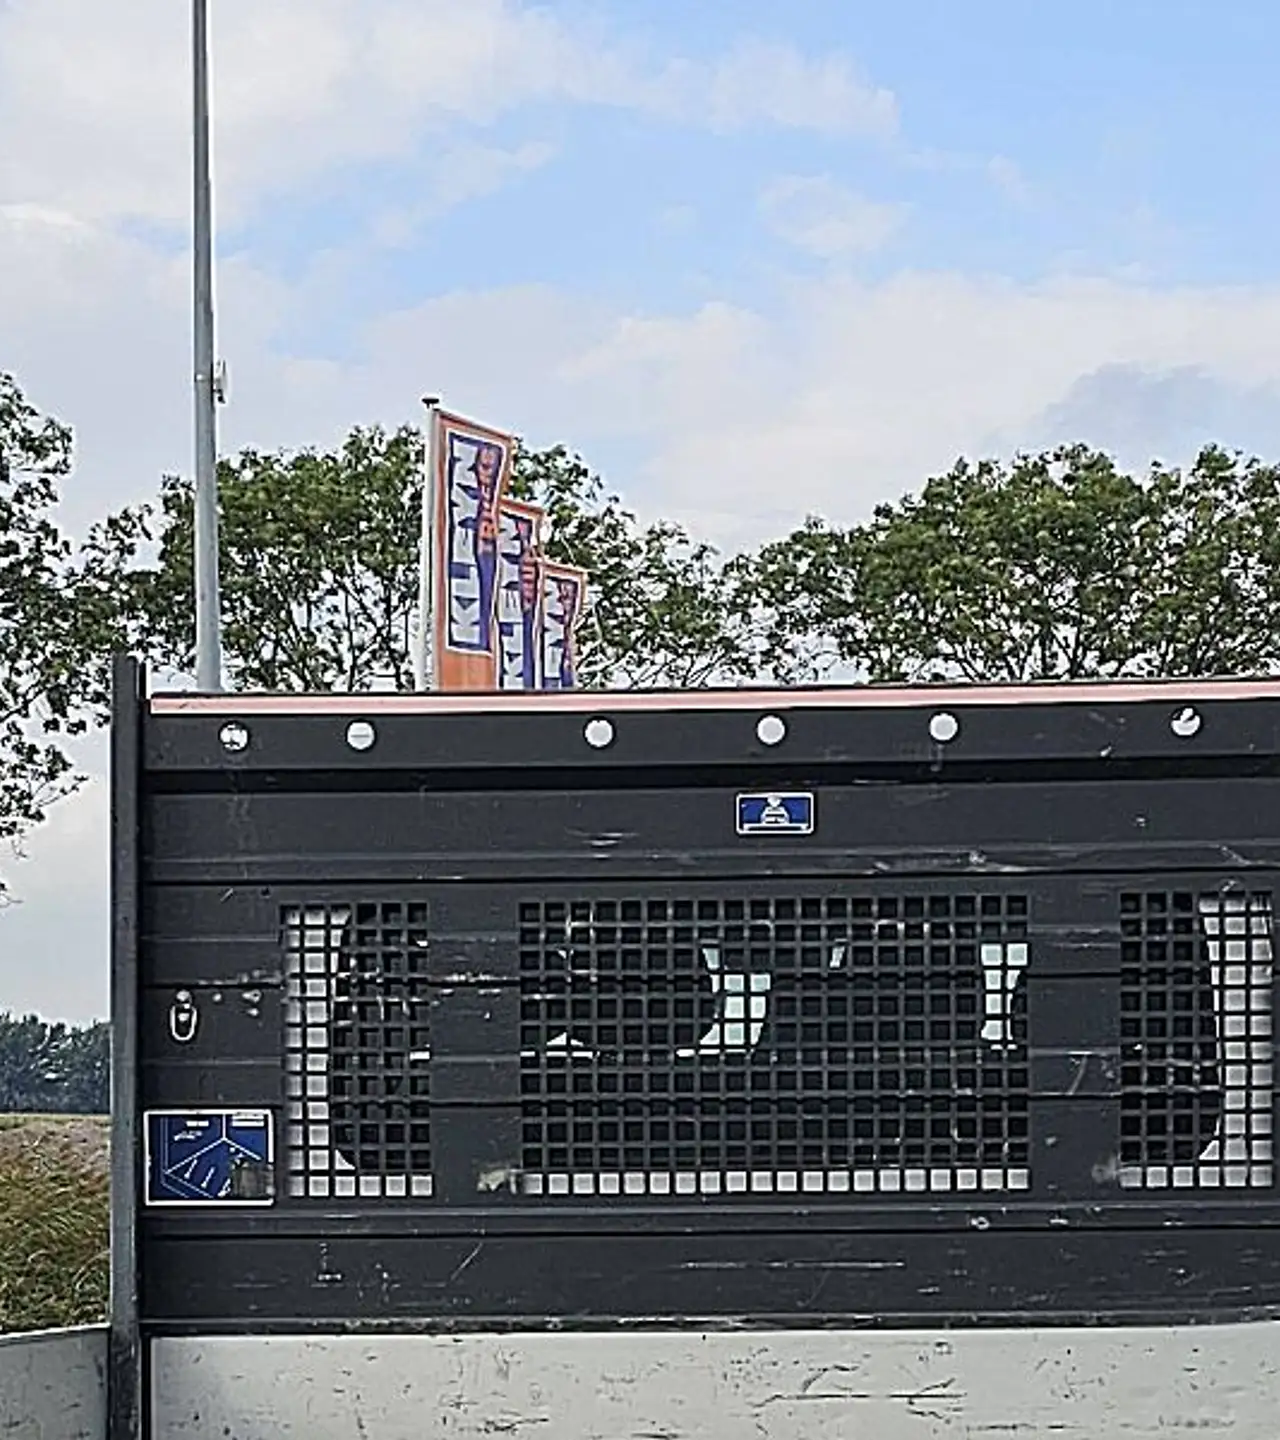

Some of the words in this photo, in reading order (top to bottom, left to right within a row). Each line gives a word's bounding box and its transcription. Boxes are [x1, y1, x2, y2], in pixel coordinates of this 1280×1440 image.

[451, 441, 480, 643] KLEYN
[477, 447, 497, 554] TRUCKS
[499, 517, 524, 690] KLEYN
